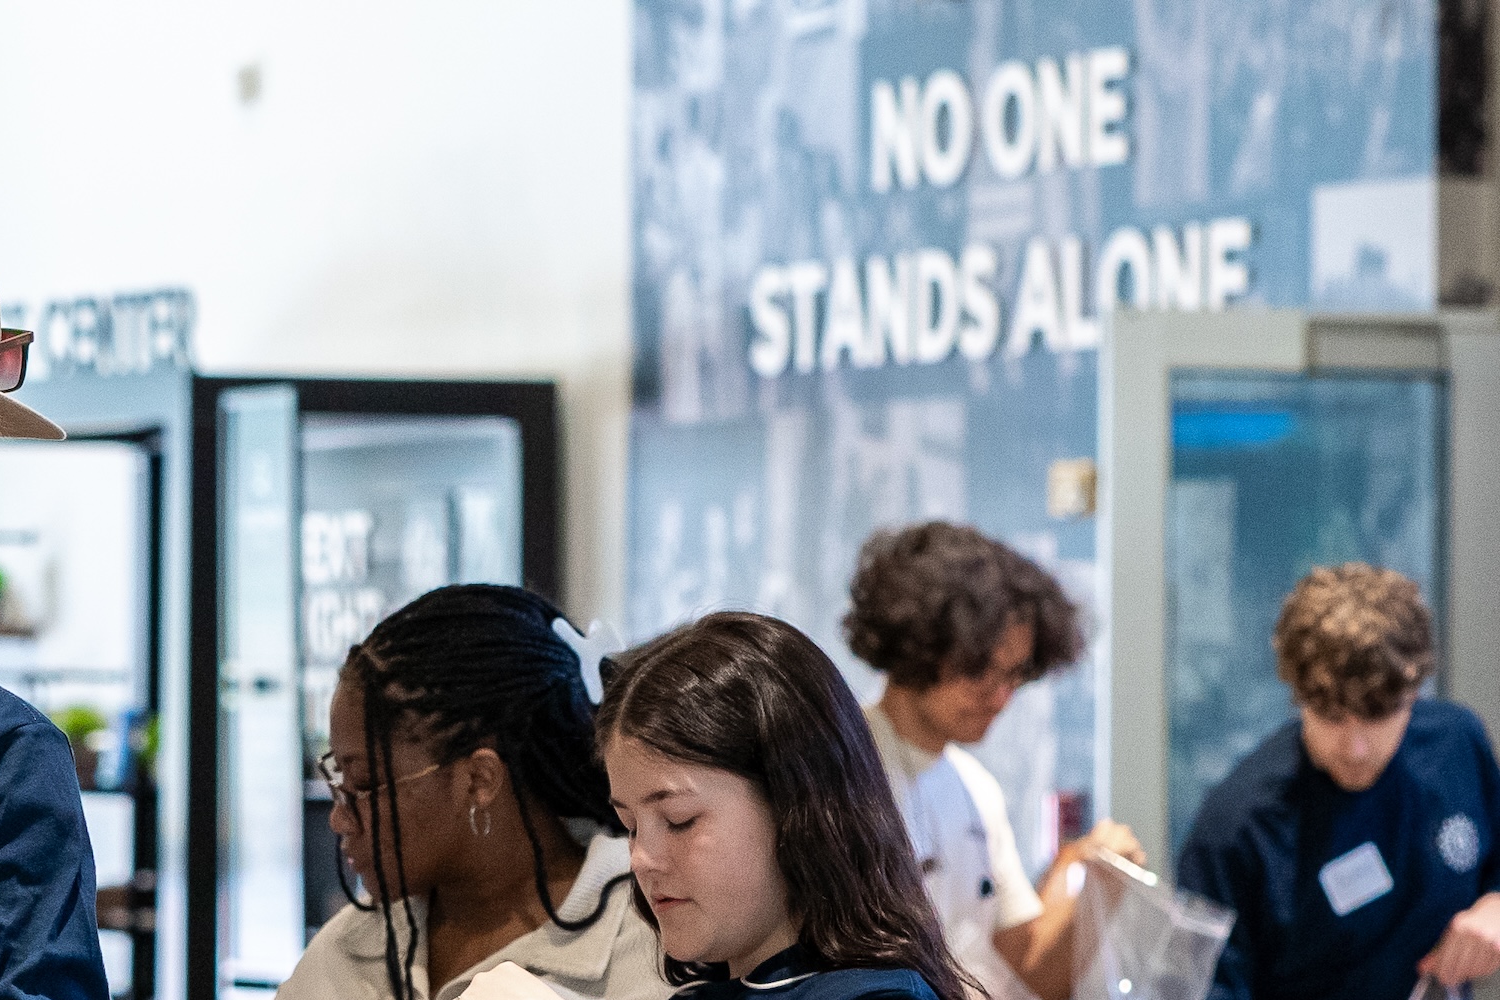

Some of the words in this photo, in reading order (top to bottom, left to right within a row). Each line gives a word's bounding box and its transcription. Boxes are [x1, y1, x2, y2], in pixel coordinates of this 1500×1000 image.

[870, 70, 972, 193] NO
[984, 46, 1129, 178] ONE
[749, 244, 999, 377] STANDS
[1002, 217, 1251, 358] ALONE
